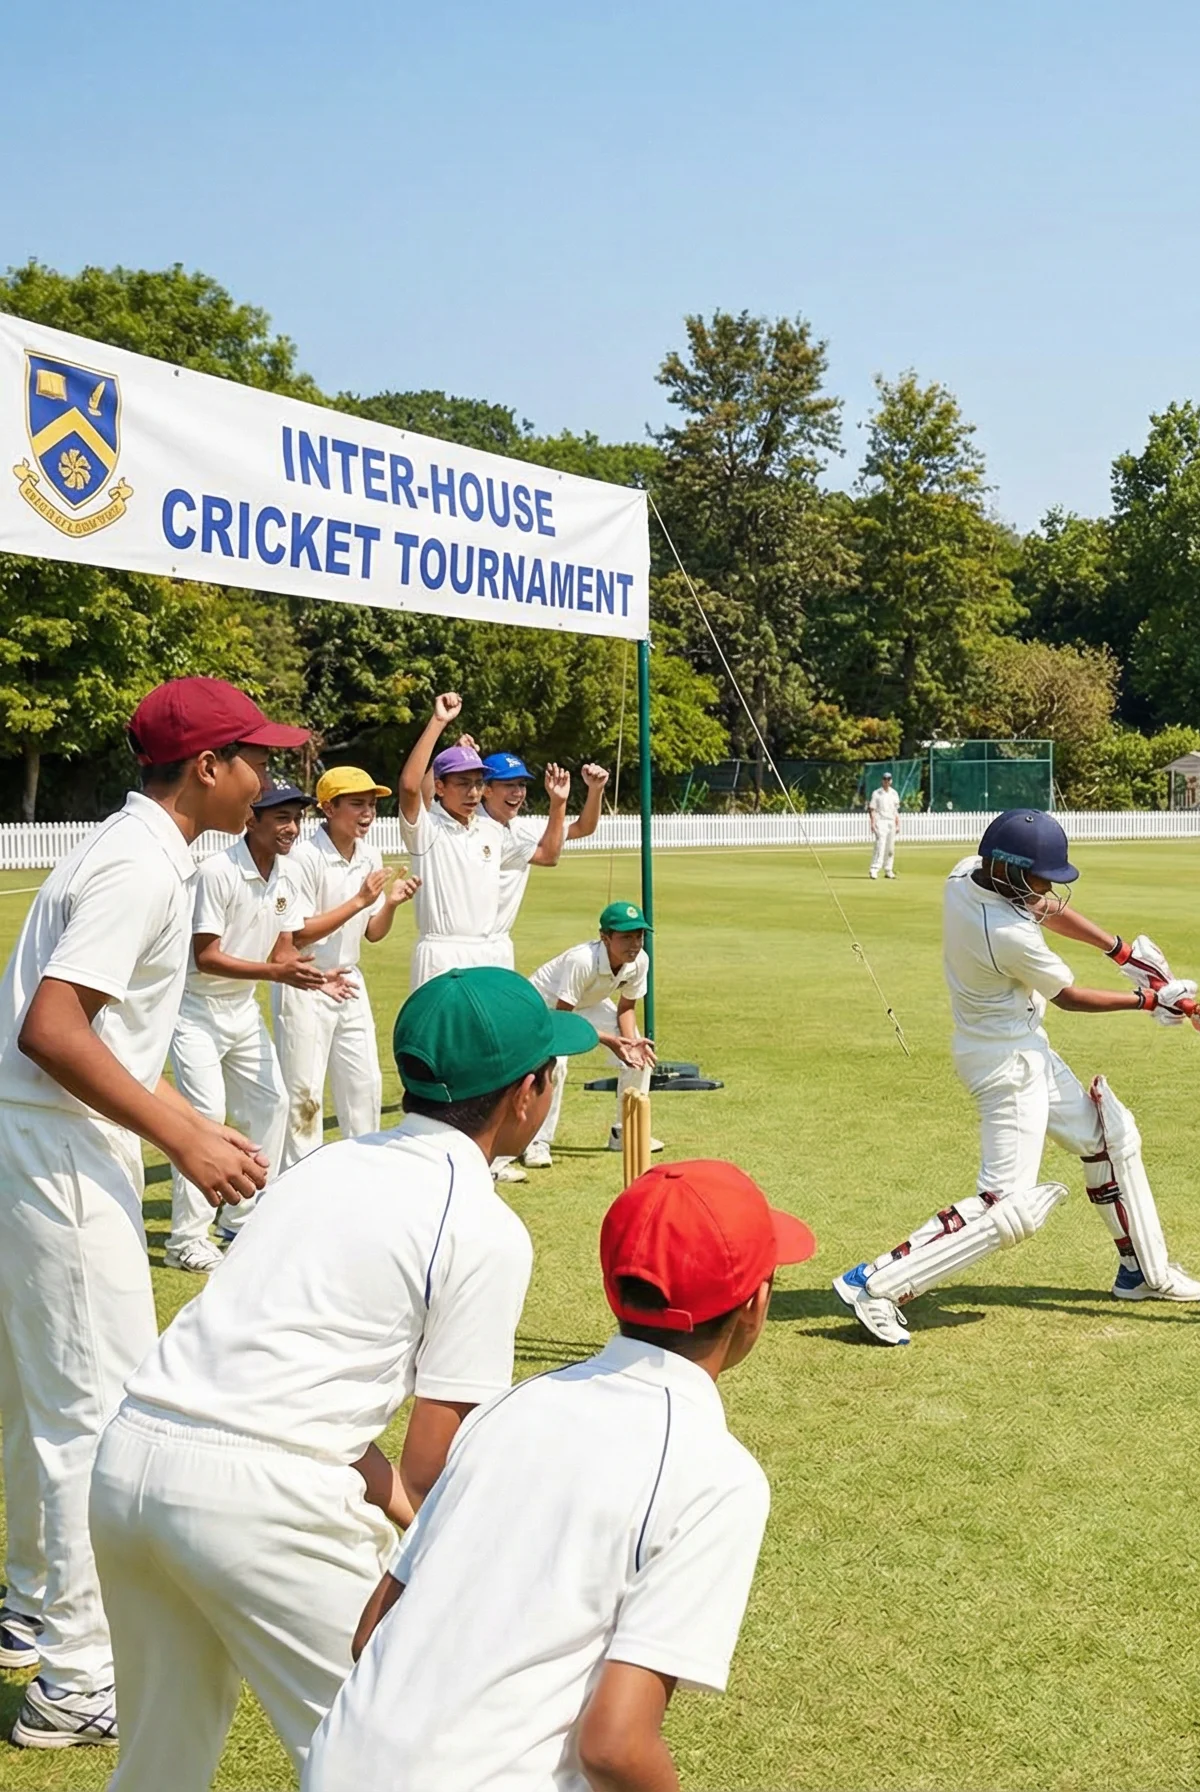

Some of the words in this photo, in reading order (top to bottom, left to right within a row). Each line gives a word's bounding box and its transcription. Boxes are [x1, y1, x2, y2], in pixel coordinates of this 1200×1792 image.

[282, 426, 556, 538] INTER-HOUSE
[162, 488, 381, 579] CRICKET
[394, 531, 634, 617] TOURNAMENT
